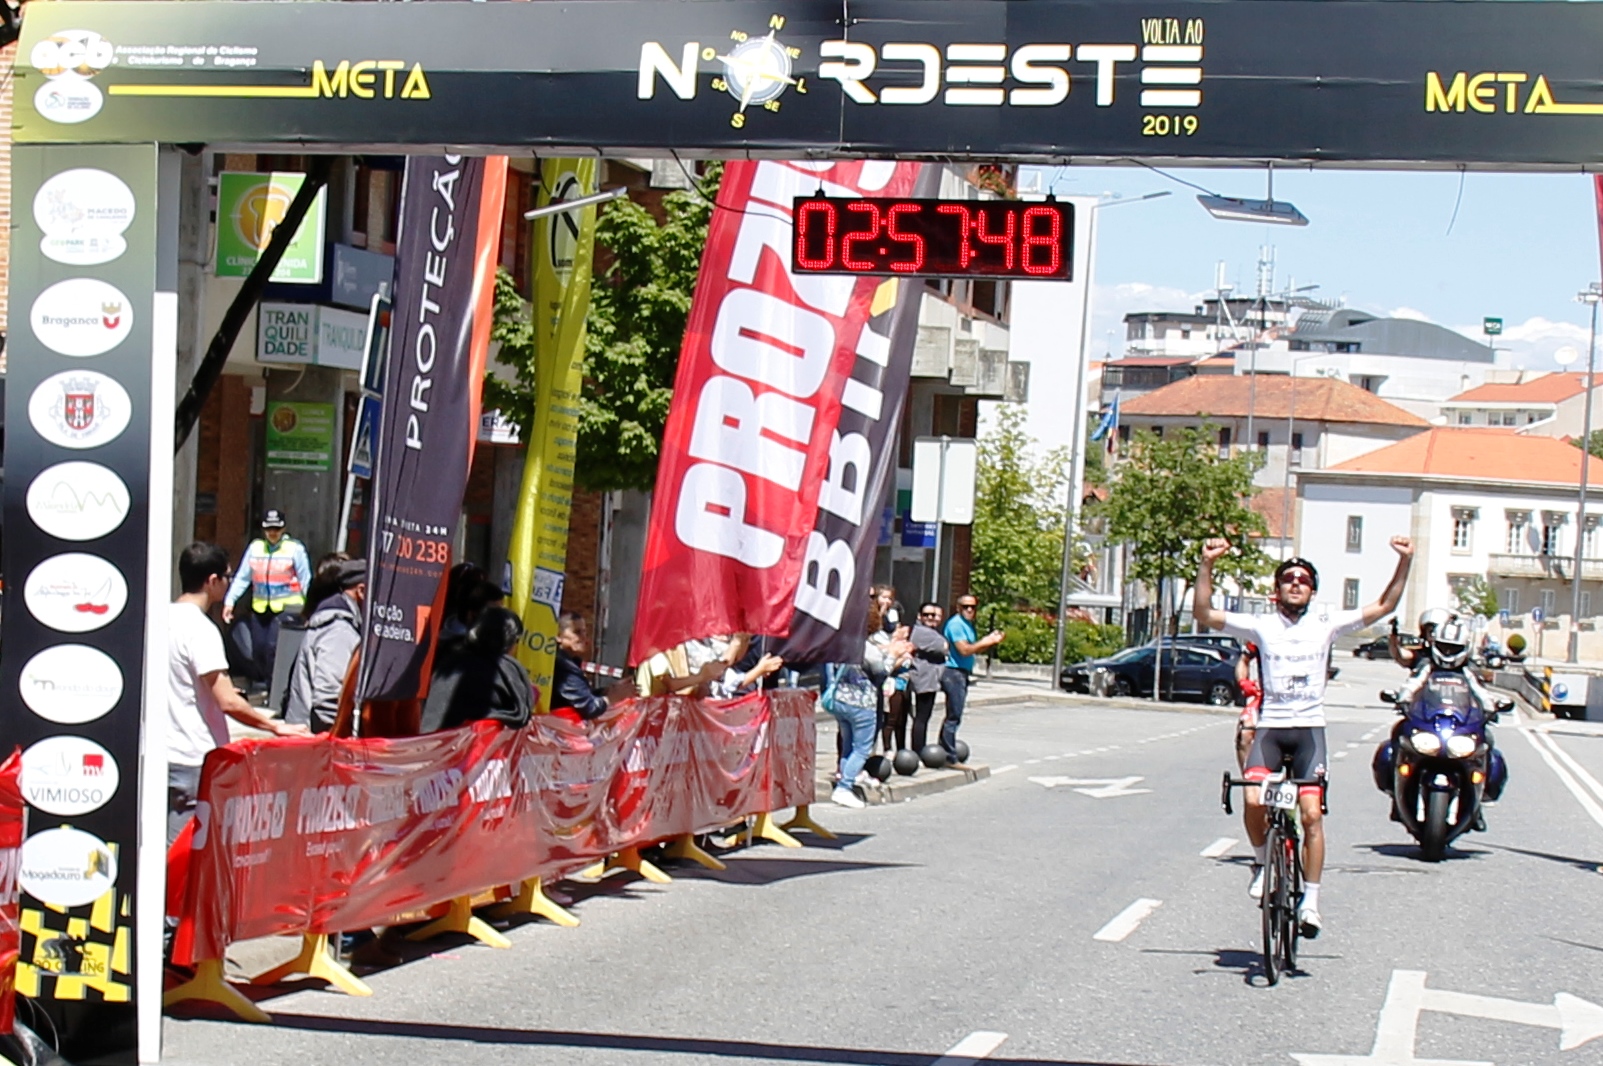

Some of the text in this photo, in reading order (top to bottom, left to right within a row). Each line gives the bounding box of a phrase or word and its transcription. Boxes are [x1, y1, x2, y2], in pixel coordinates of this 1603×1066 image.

[769, 14, 785, 30] N
[1141, 18, 1203, 43] VOLTA AO
[166, 46, 206, 56] Regional
[206, 46, 218, 55] de
[219, 46, 258, 55] Ciclismo
[311, 60, 431, 98] META
[1425, 71, 1556, 113] META
[731, 113, 745, 128] S
[1142, 115, 1198, 136] 2019
[797, 201, 1061, 274] 02:57:48
[265, 310, 309, 325] TRAN
[264, 325, 309, 341] QUILI
[264, 341, 309, 356] DADE
[416, 539, 448, 564] 238
[29, 787, 104, 804] VIMIOSO
[1264, 789, 1294, 805] 009
[21, 869, 81, 882] Mogadouro
